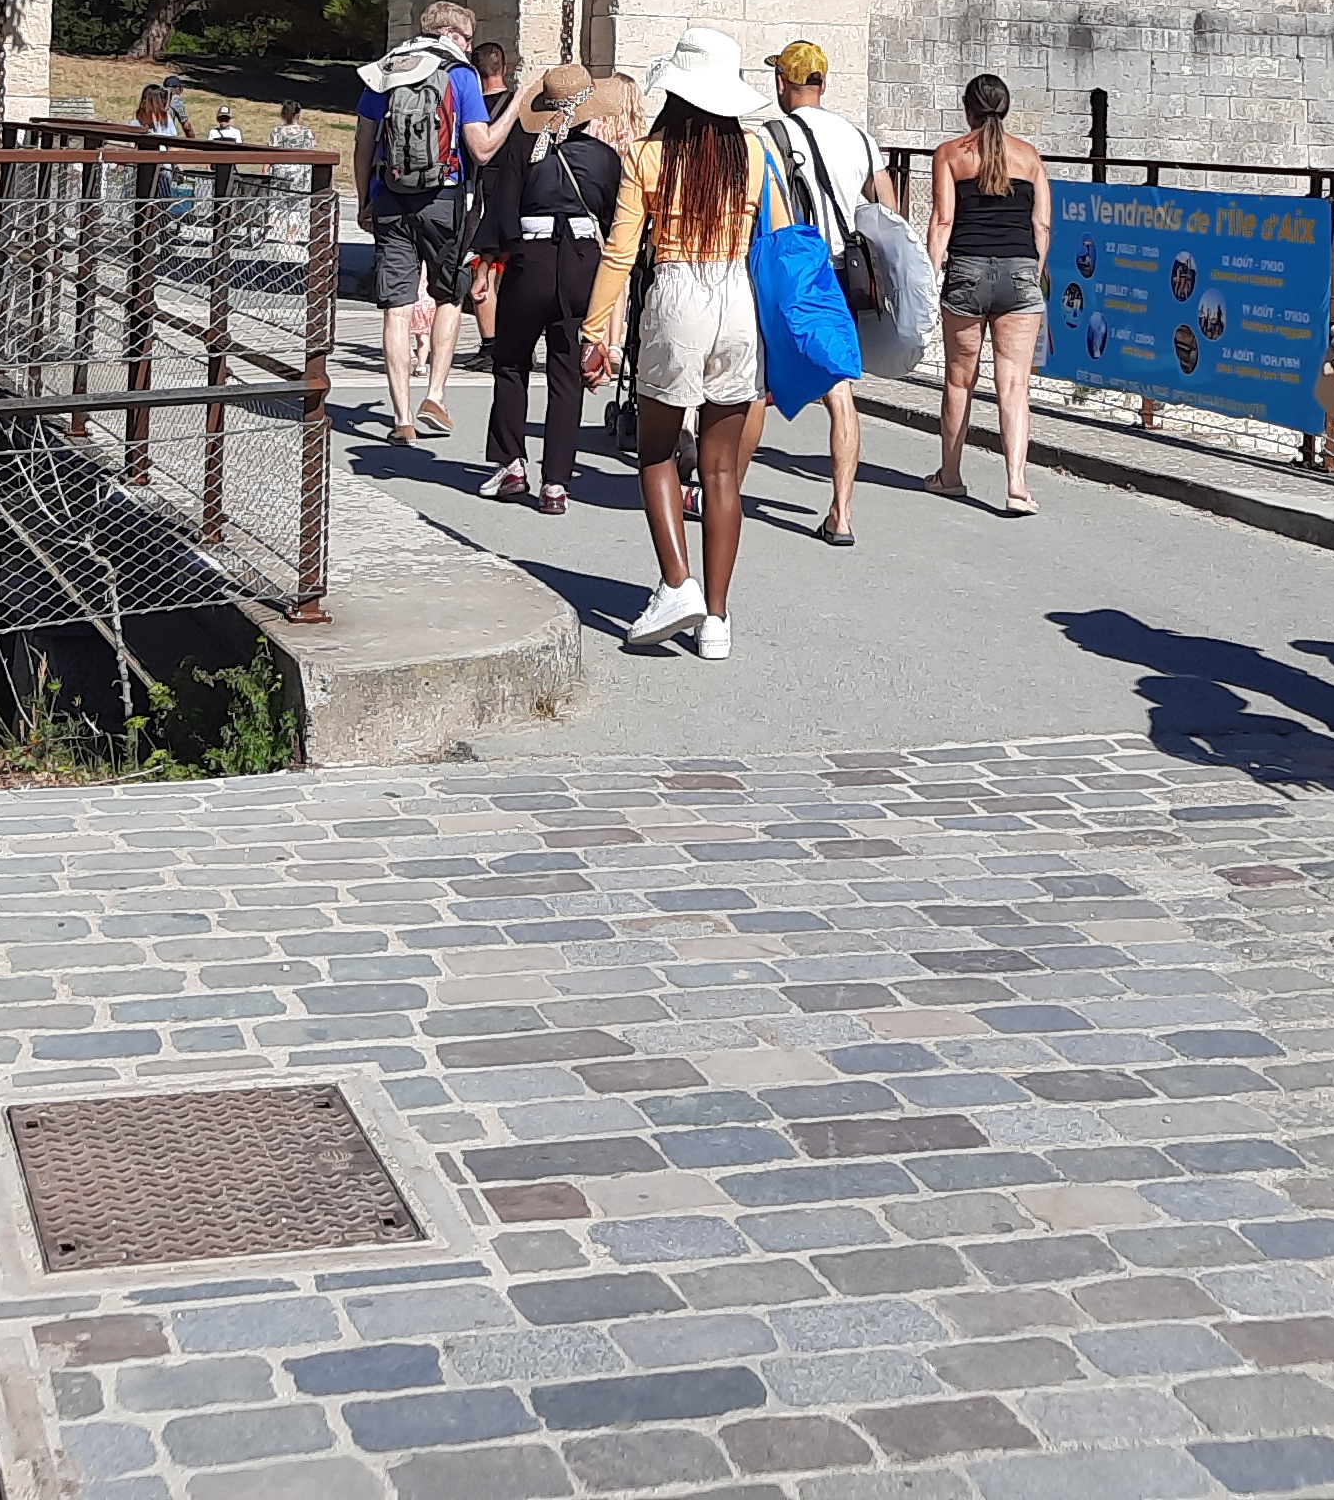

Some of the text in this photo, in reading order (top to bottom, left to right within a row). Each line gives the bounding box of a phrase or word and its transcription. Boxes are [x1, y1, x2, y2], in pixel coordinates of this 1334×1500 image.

[1062, 197, 1087, 222] Les
[1090, 194, 1184, 232] Vendredis
[1186, 207, 1210, 235] de
[1261, 208, 1316, 244] d'Aix
